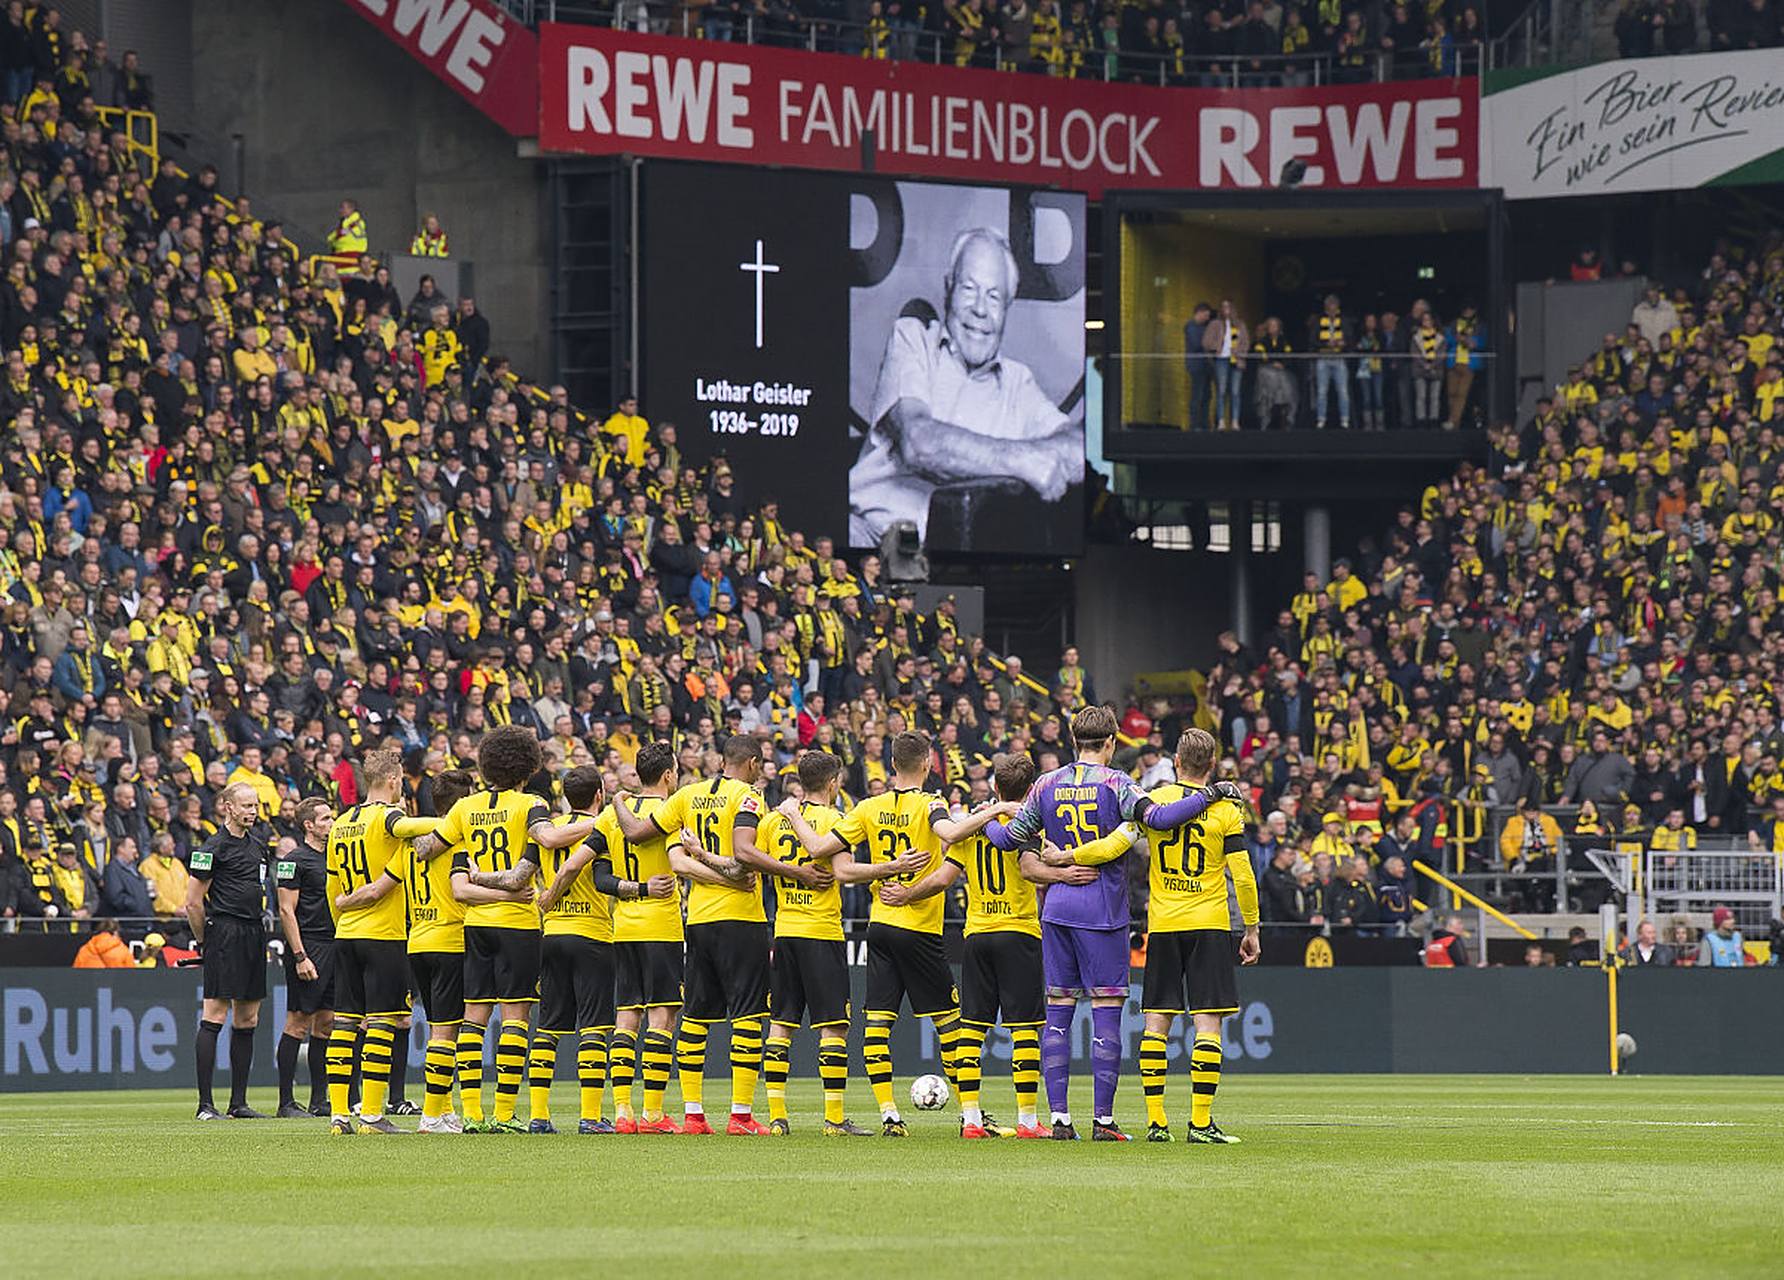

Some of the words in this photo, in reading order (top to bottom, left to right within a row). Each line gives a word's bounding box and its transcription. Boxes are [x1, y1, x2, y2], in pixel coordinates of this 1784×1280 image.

[567, 45, 754, 149] REWE
[779, 79, 1162, 177] FAMILIENBLOCK
[1199, 97, 1464, 187] REWE
[1526, 105, 1585, 181] Ein
[1584, 70, 1682, 129] Bier
[1566, 142, 1611, 186] wie
[1619, 113, 1677, 155] sein
[696, 378, 751, 403] Lothar
[753, 381, 812, 406] Geisler
[471, 826, 512, 871] 28
[696, 811, 721, 856] 16
[1056, 803, 1100, 851] 35
[1158, 822, 1205, 877] 26
[335, 839, 372, 896] 34
[410, 851, 432, 905] 13
[976, 839, 1006, 895] 10
[4, 987, 178, 1074] Ruhe
